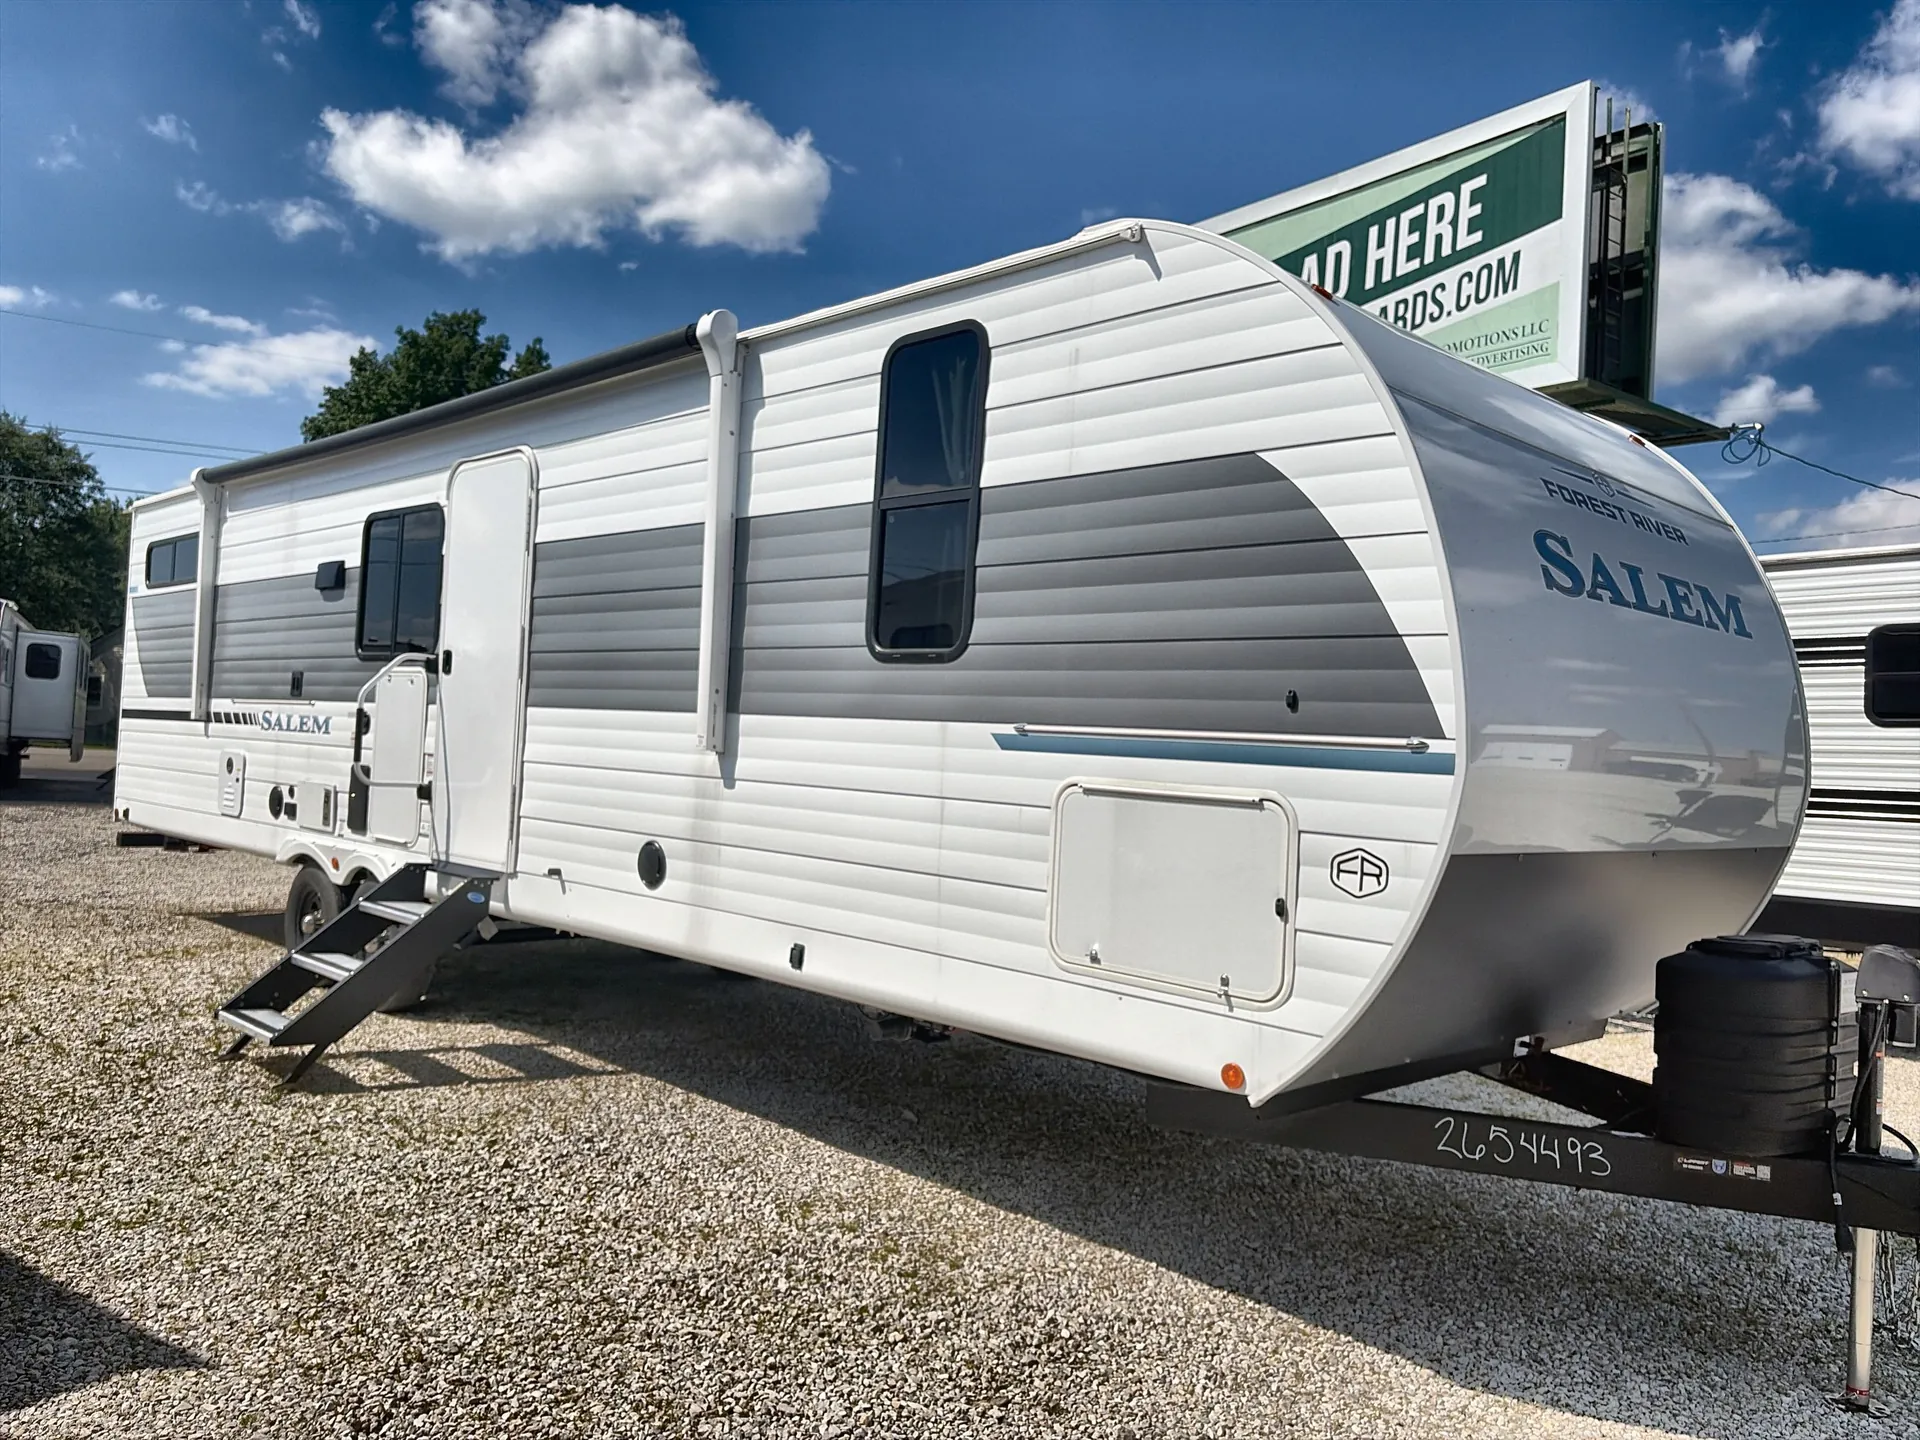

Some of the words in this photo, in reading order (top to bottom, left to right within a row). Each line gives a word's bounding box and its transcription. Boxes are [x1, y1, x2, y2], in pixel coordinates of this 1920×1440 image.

[1364, 172, 1488, 291] HERE
[1471, 341, 1549, 366] DVERTISING
[1521, 319, 1549, 338] LLC
[1540, 477, 1628, 525] FOREST
[1630, 511, 1690, 547] RIVER
[1532, 528, 1754, 640] SALEM
[261, 709, 333, 735] SALEM
[1434, 1116, 1611, 1176] 2654493
